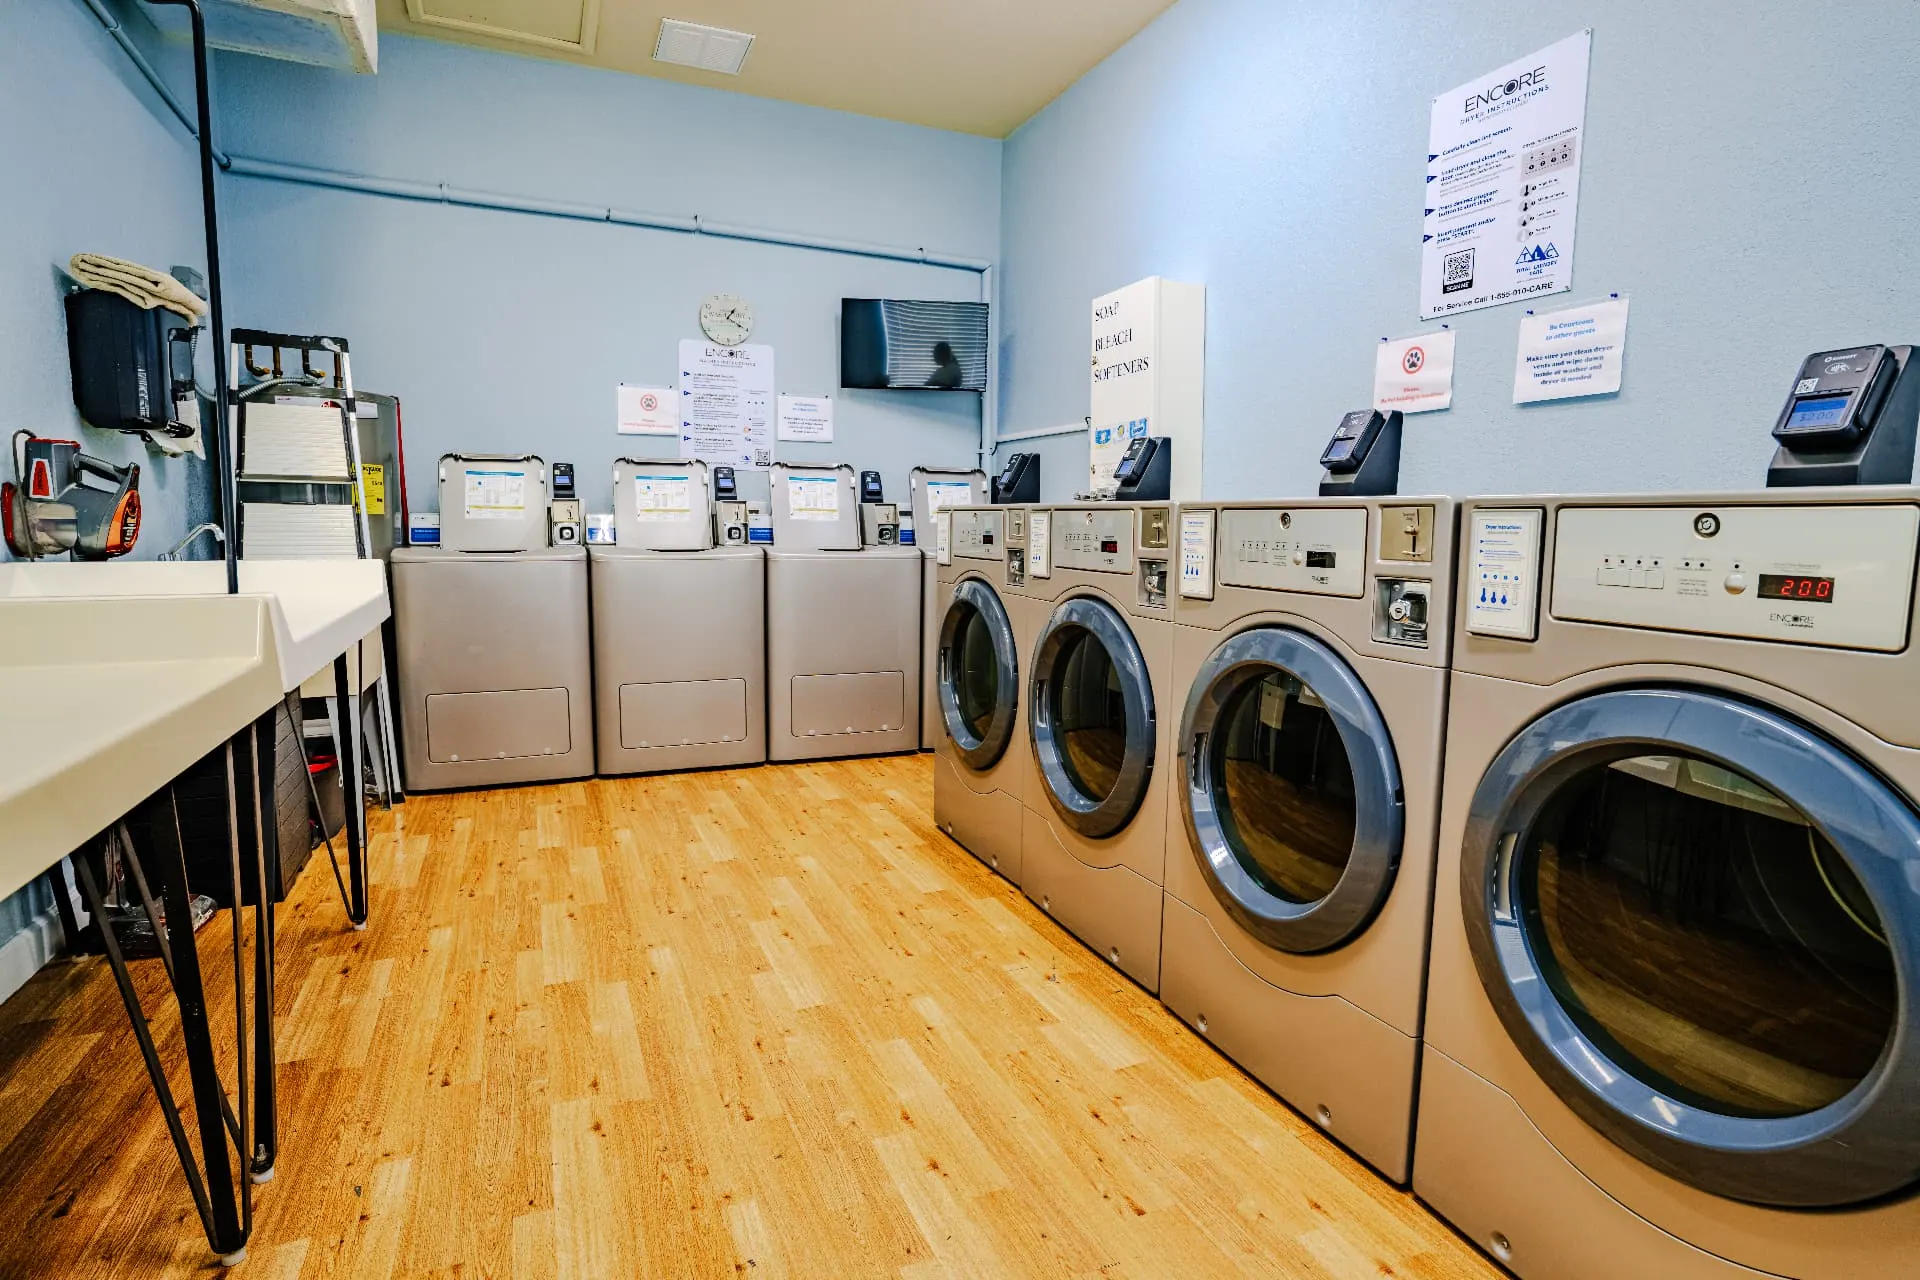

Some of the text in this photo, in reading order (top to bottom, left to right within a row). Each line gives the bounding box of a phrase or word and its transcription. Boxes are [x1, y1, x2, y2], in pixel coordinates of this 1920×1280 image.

[1465, 65, 1546, 113] ENCORE
[1487, 84, 1550, 114] INSTRUCTIONS
[1095, 301, 1120, 322] SOAP
[1433, 305, 1444, 313] For
[1446, 300, 1473, 310] Service
[1474, 295, 1489, 304] Call
[1095, 328, 1133, 352] BLEACH
[1553, 331, 1573, 340] other
[1573, 327, 1596, 338] guests
[705, 348, 751, 360] ENCORE
[1526, 354, 1543, 363] Make
[1559, 351, 1573, 360] you
[1574, 347, 1593, 356] clean
[1593, 344, 1615, 355] dryer
[1566, 358, 1583, 368] wipe
[1584, 355, 1604, 363] down
[1094, 356, 1150, 383] SOFTENERS
[1562, 366, 1588, 375] washer
[1589, 363, 1603, 371] and
[1540, 378, 1560, 386] dryer
[1780, 579, 1831, 597] 200
[1769, 613, 1815, 625] ENCORE
